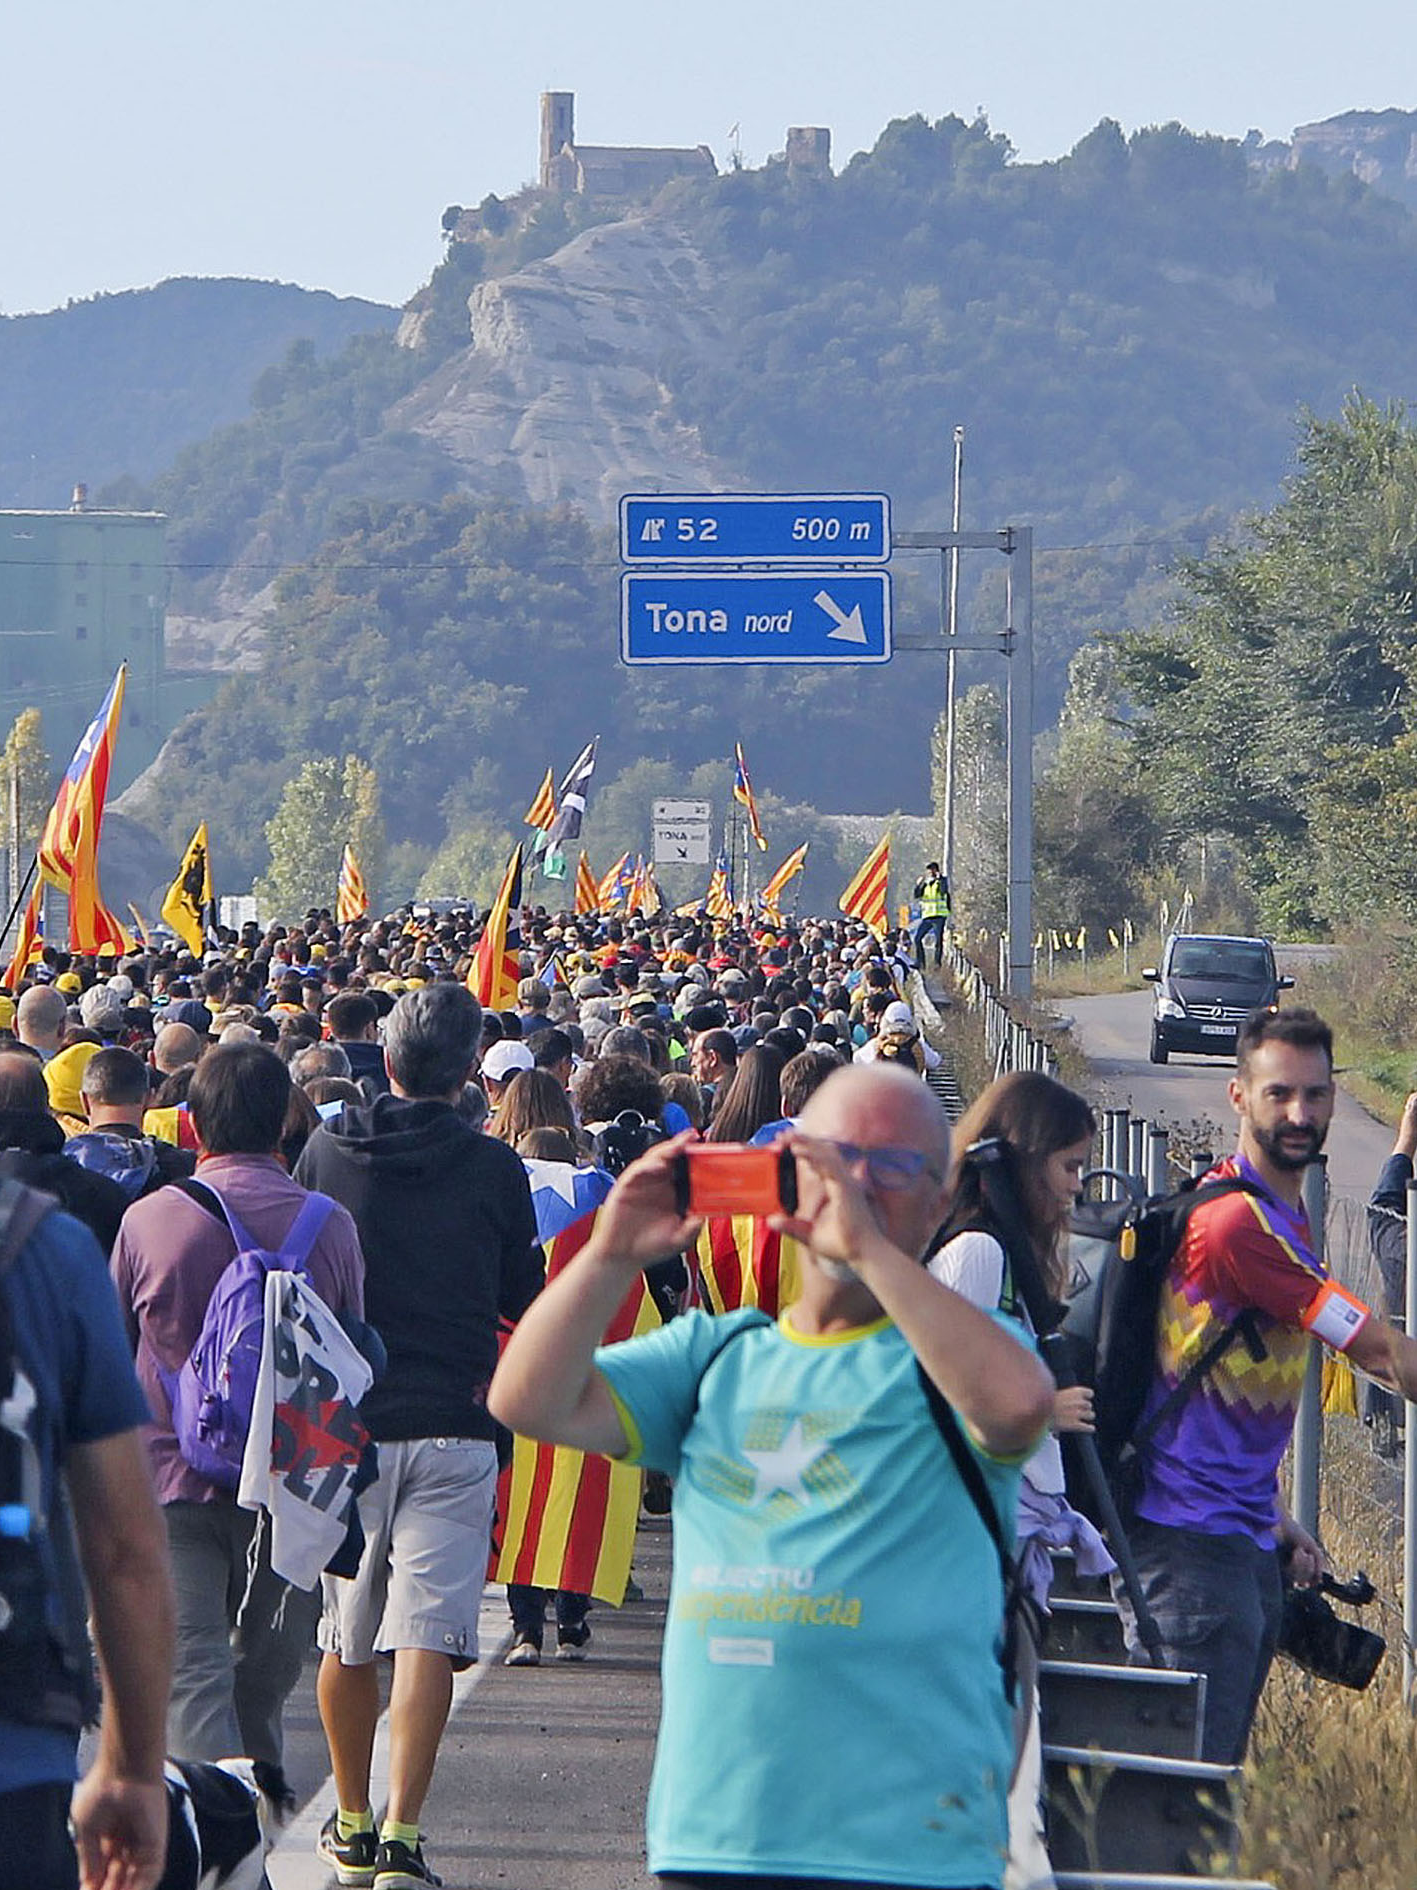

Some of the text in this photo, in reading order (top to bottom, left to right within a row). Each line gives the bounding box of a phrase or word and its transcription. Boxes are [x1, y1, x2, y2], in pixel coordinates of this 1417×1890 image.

[677, 518, 871, 541] 52 500 m
[645, 602, 793, 634] Tona nord
